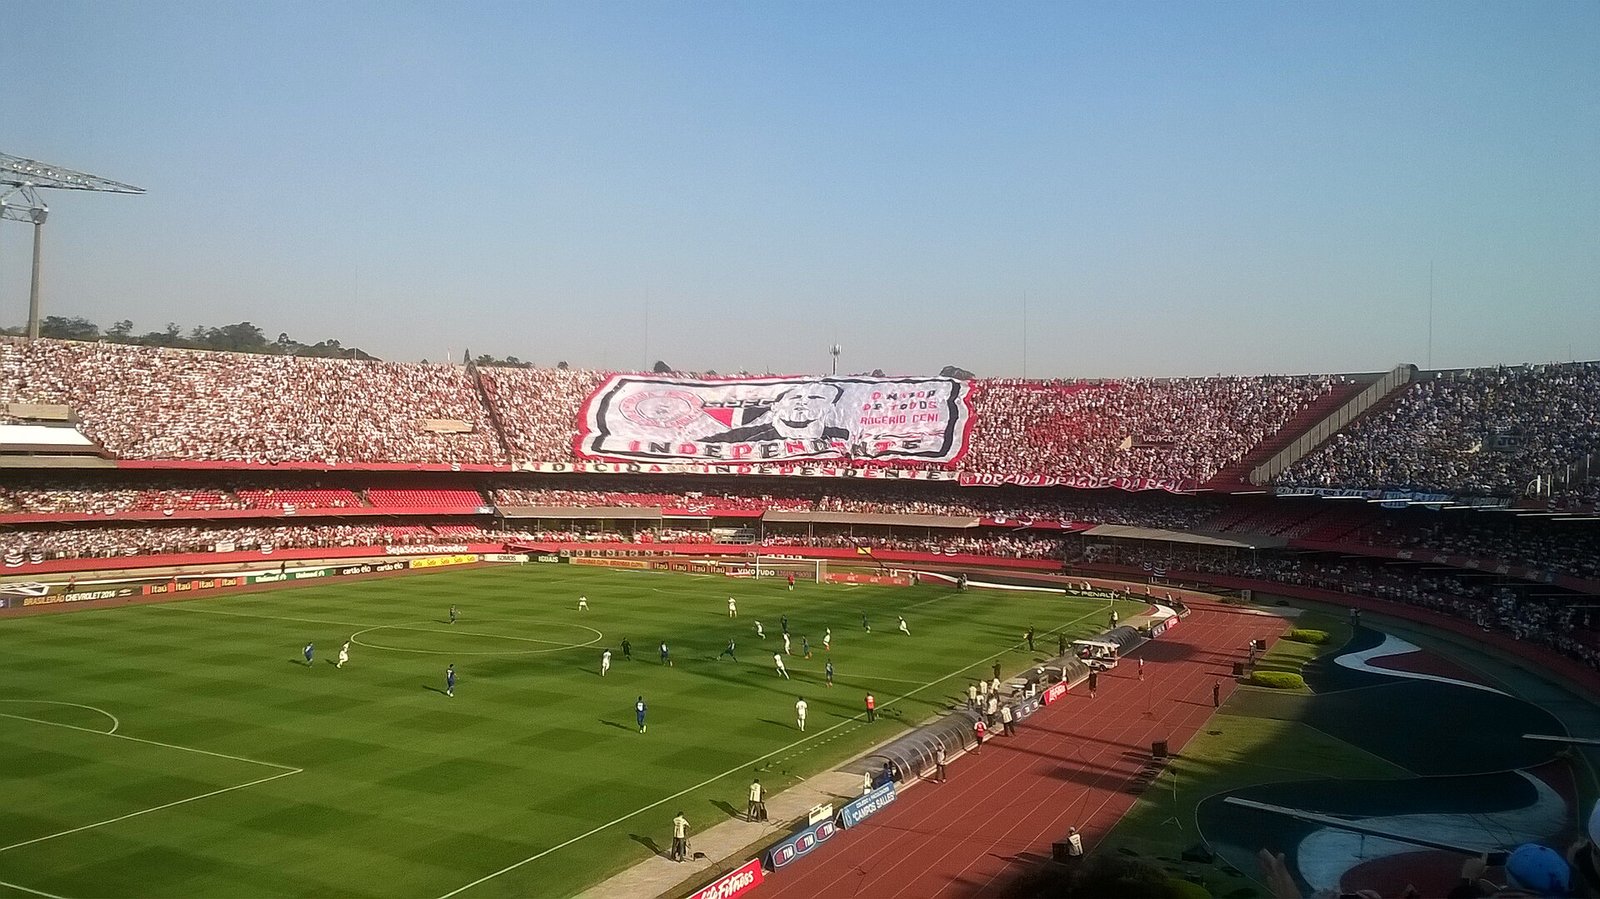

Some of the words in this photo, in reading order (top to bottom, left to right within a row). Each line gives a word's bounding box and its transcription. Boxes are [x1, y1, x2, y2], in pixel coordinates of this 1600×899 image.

[889, 401, 938, 410] TODOS
[912, 413, 938, 423] CENI
[974, 472, 1041, 485] TORCIDA
[1121, 477, 1140, 489] DA
[1144, 478, 1184, 491] REAL
[175, 582, 191, 591] Itaú
[199, 580, 214, 589] Itaú
[221, 578, 236, 587] Itaú
[151, 585, 168, 594] Itaú
[65, 591, 100, 602] CHEVROLET
[100, 590, 116, 599] 2014
[1081, 591, 1120, 599] PENALTY
[823, 823, 834, 836] TIM
[803, 834, 814, 848] TIM
[782, 846, 794, 860] TIM
